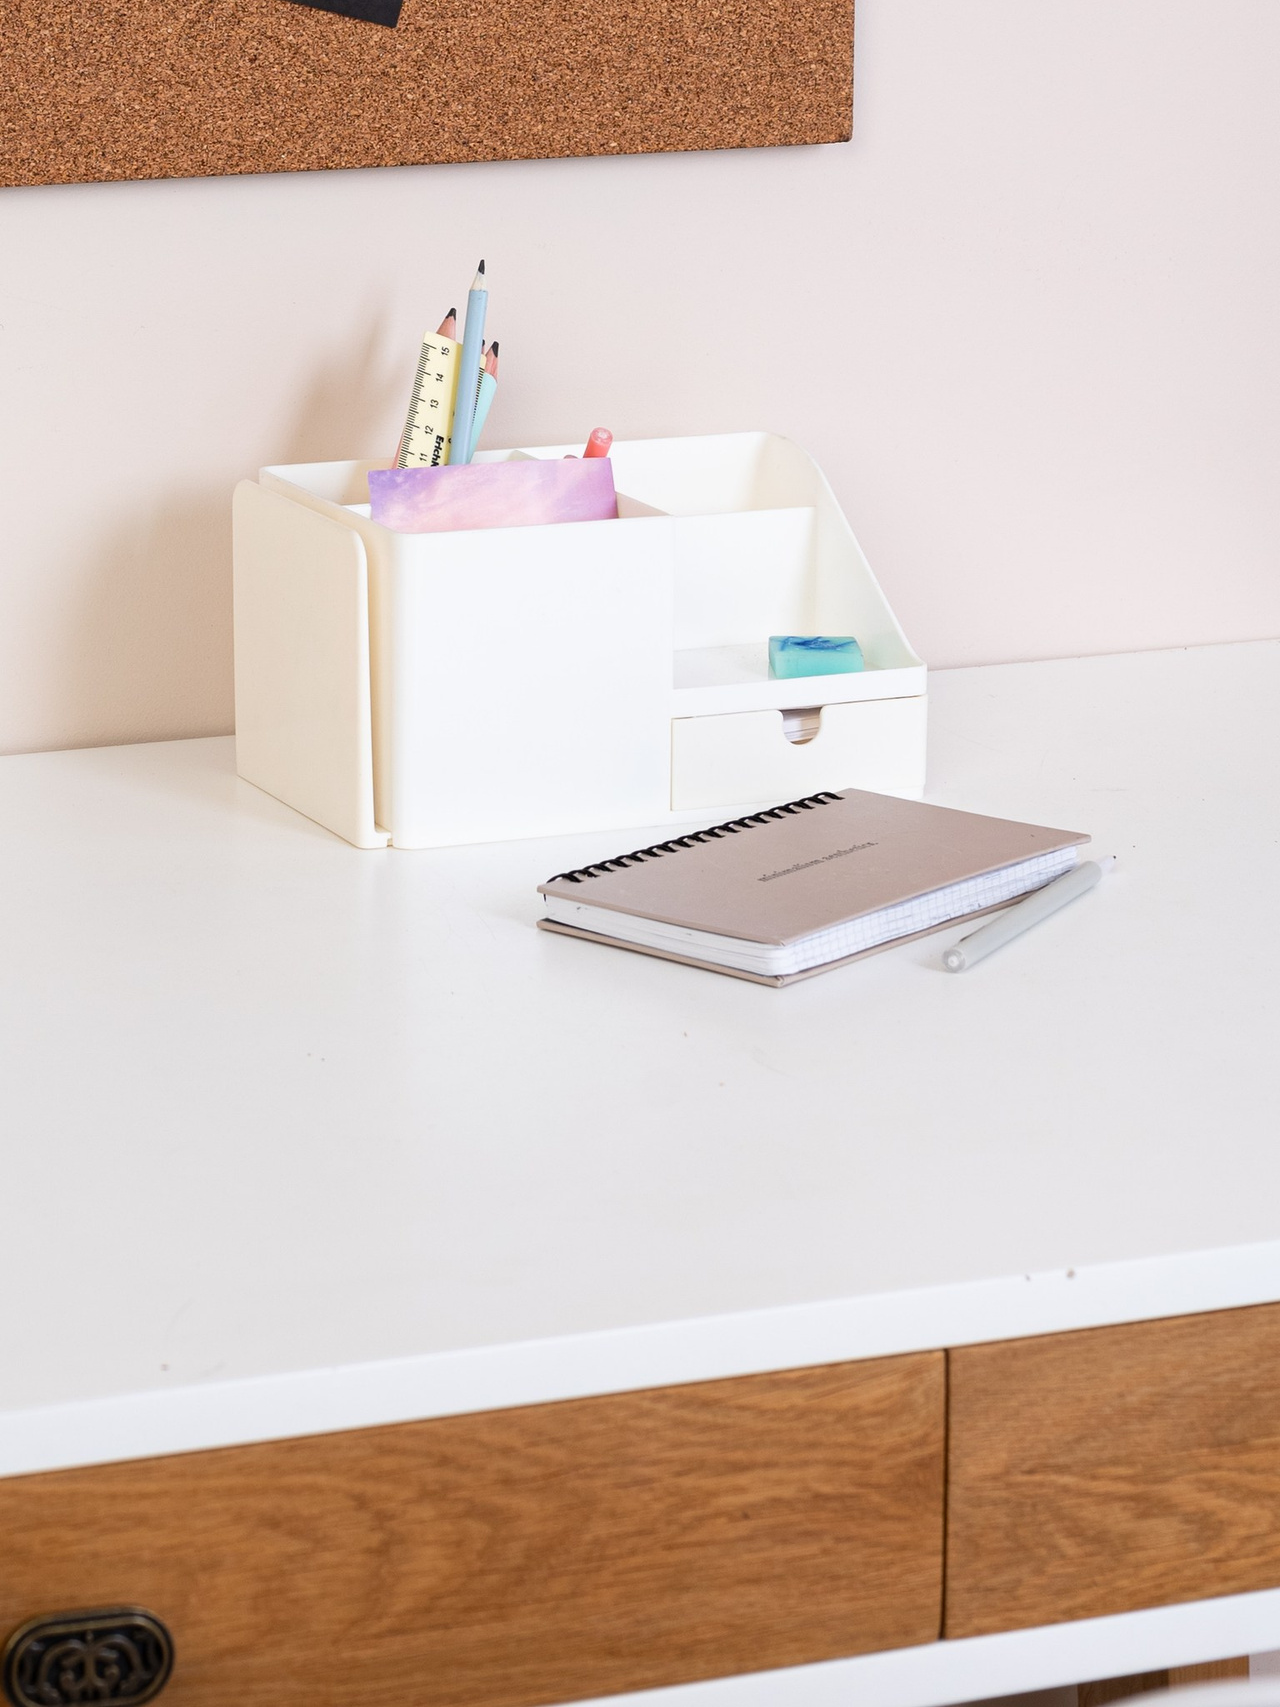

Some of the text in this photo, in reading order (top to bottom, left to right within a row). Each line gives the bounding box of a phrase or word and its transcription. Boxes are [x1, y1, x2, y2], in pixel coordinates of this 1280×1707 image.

[441, 346, 450, 356] 15
[436, 372, 444, 382] 14
[430, 399, 439, 409] 13
[424, 425, 434, 435] 12
[419, 452, 428, 462] 11
